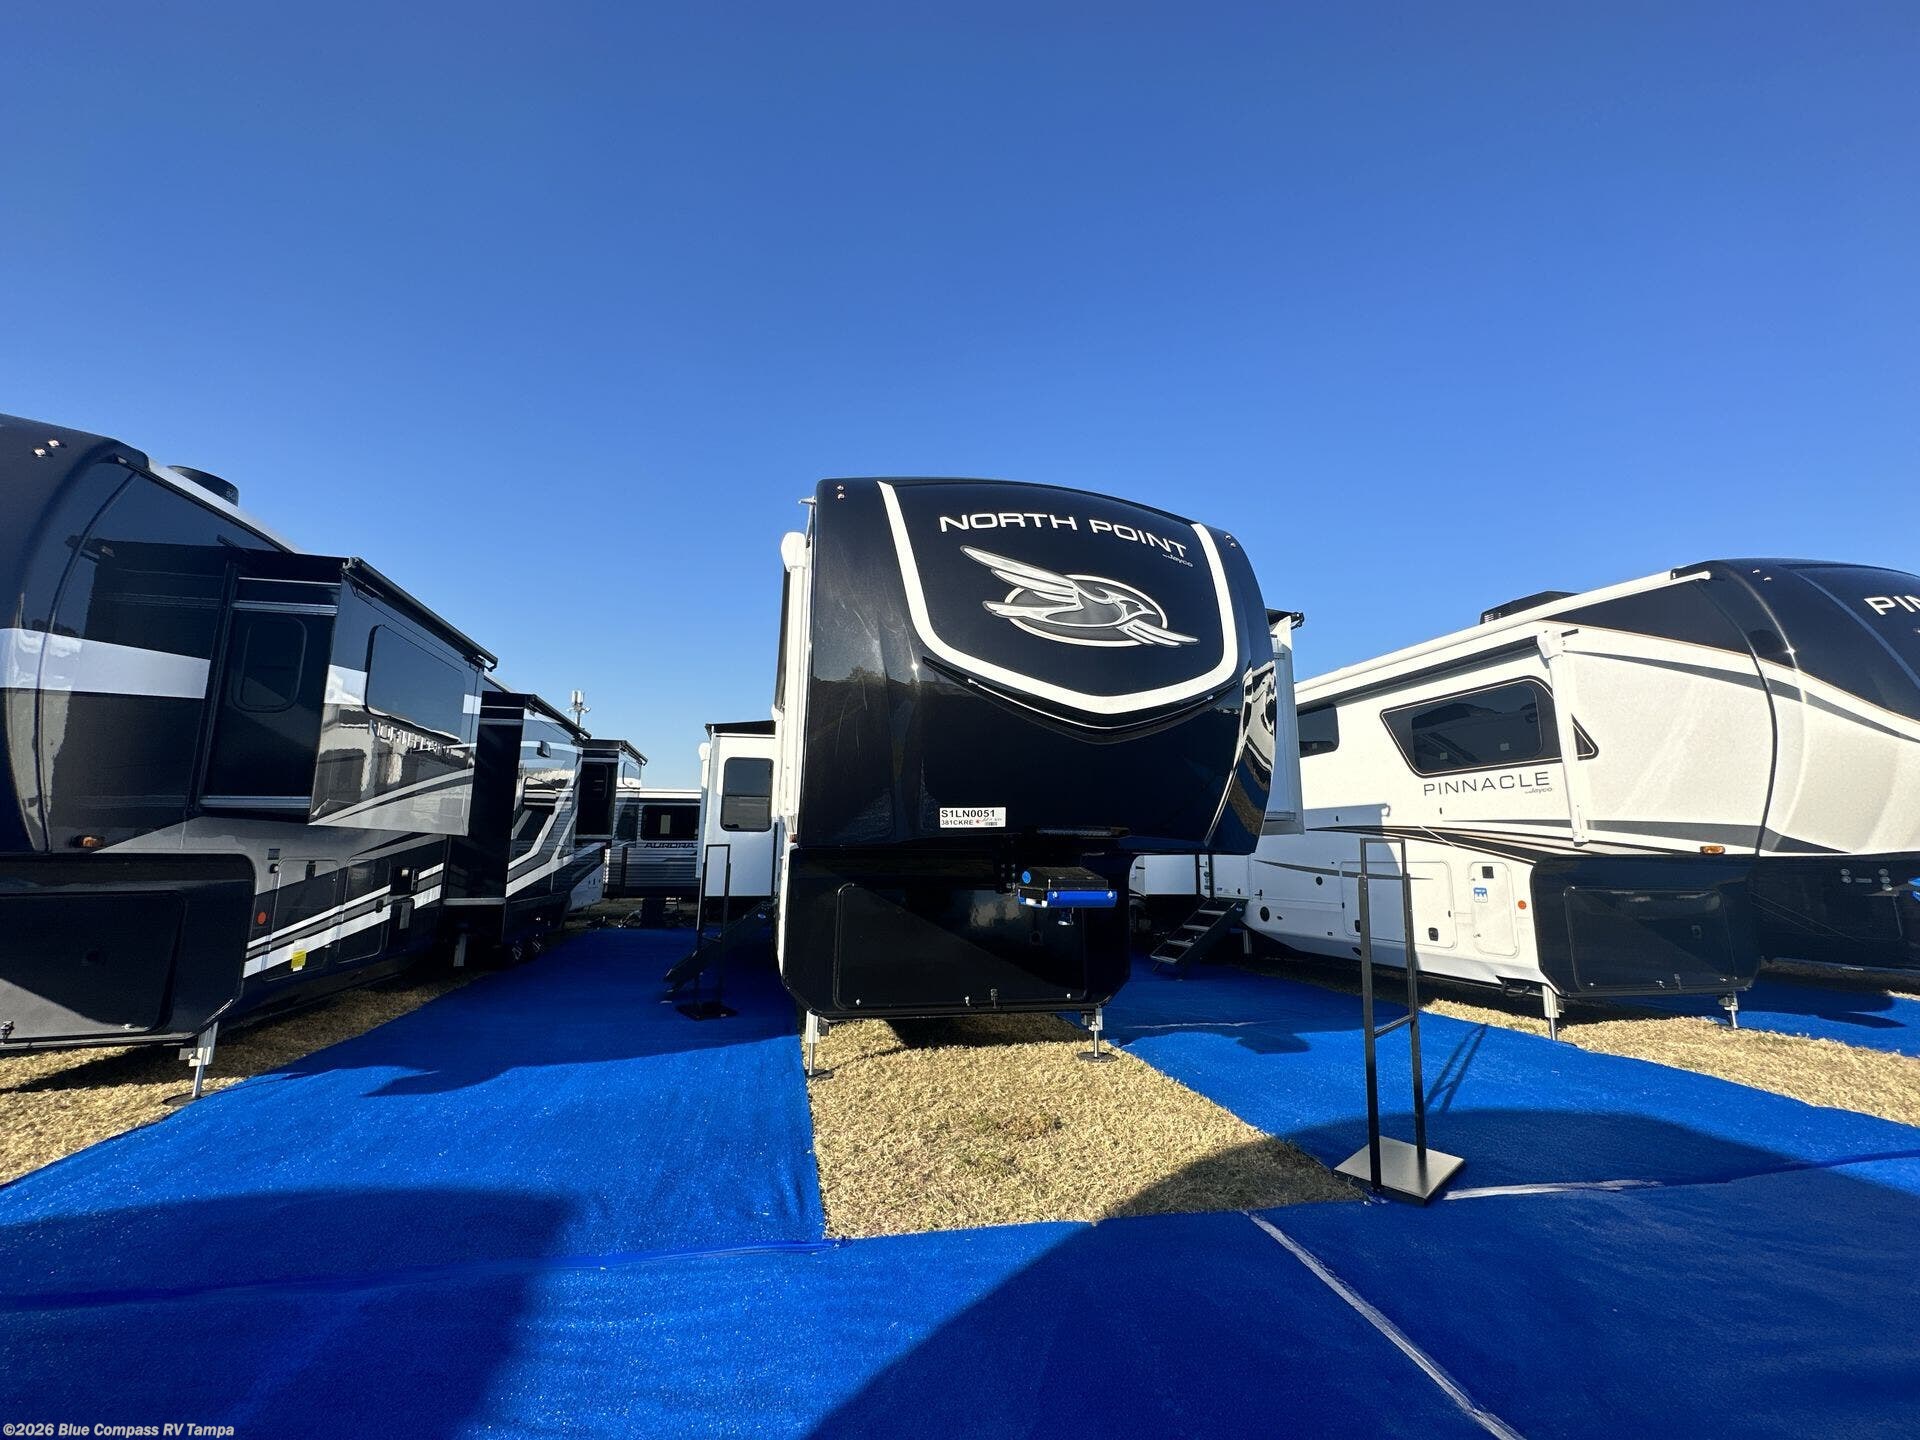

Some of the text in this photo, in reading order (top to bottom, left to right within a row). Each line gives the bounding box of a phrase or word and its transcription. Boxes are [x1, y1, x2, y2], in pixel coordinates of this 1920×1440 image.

[939, 512, 1187, 557] NORTH POINT
[1423, 771, 1550, 797] PINNACLE
[941, 809, 995, 818] S1LN0051
